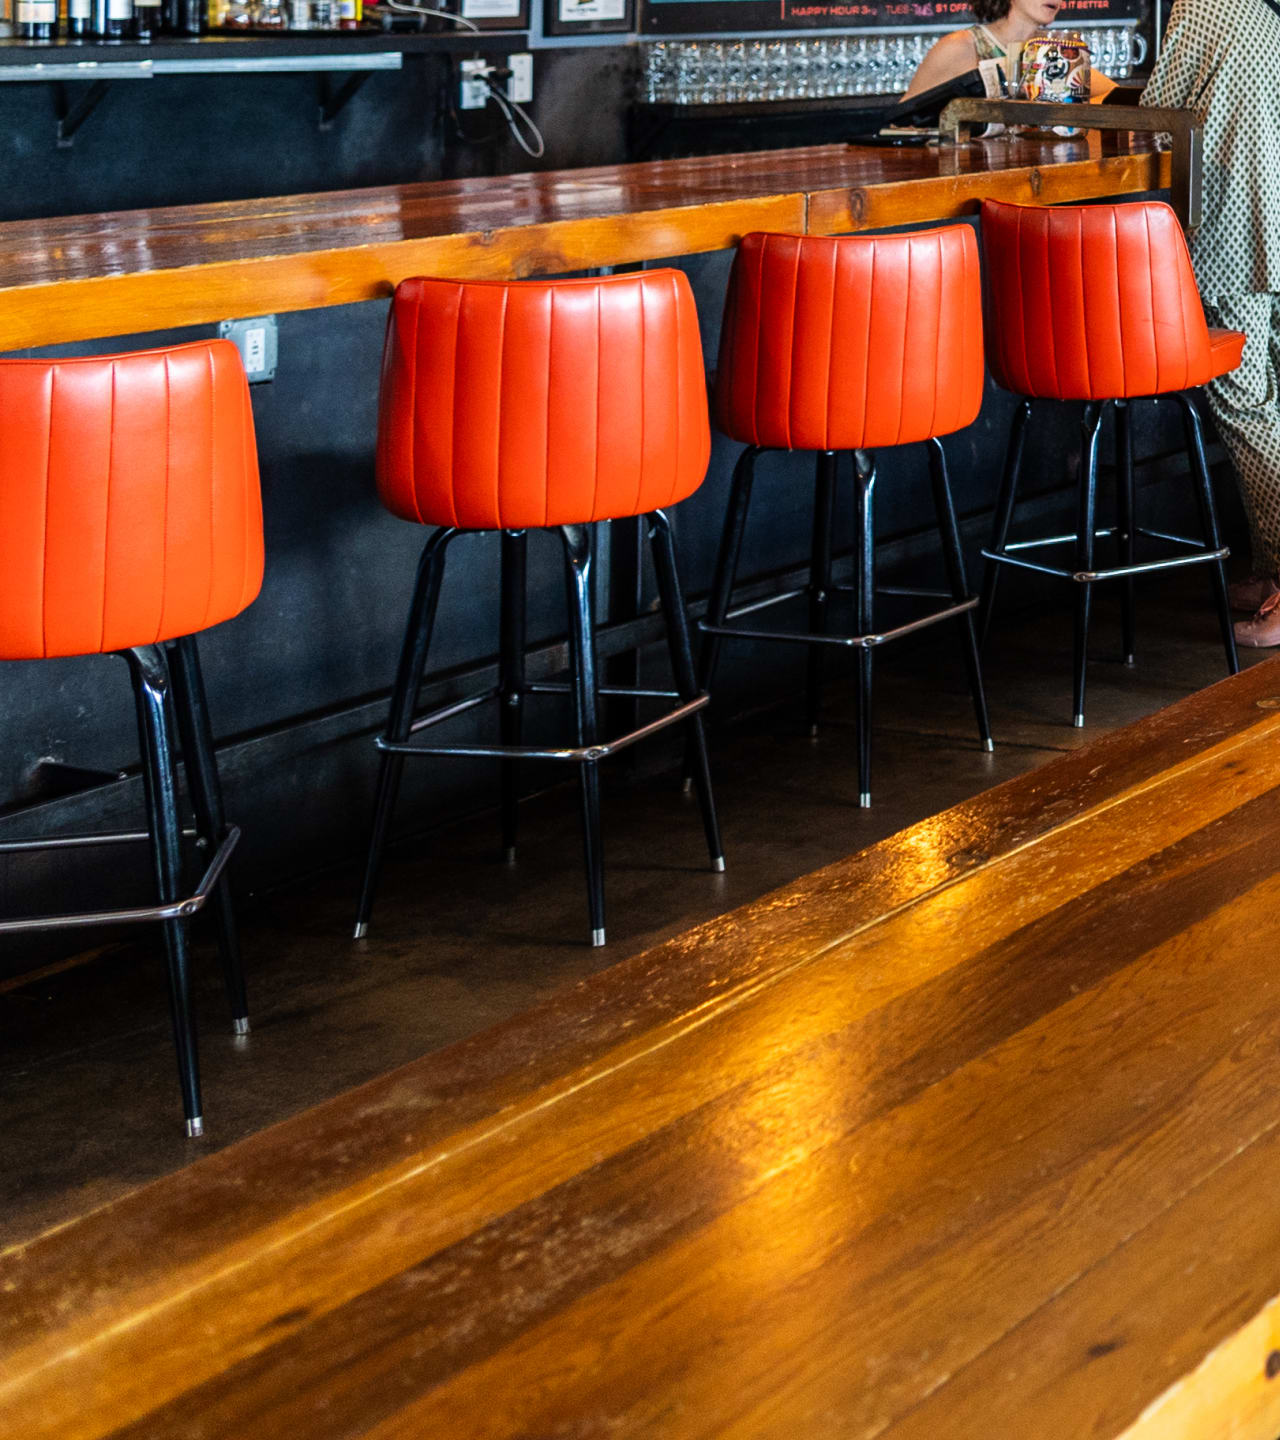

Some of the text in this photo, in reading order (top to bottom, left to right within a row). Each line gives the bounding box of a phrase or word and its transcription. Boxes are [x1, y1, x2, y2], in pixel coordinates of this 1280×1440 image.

[791, 6, 829, 17] HAPPY
[830, 5, 862, 16] HOUR
[950, 2, 967, 13] OFF
[1077, 0, 1110, 10] BETTER
